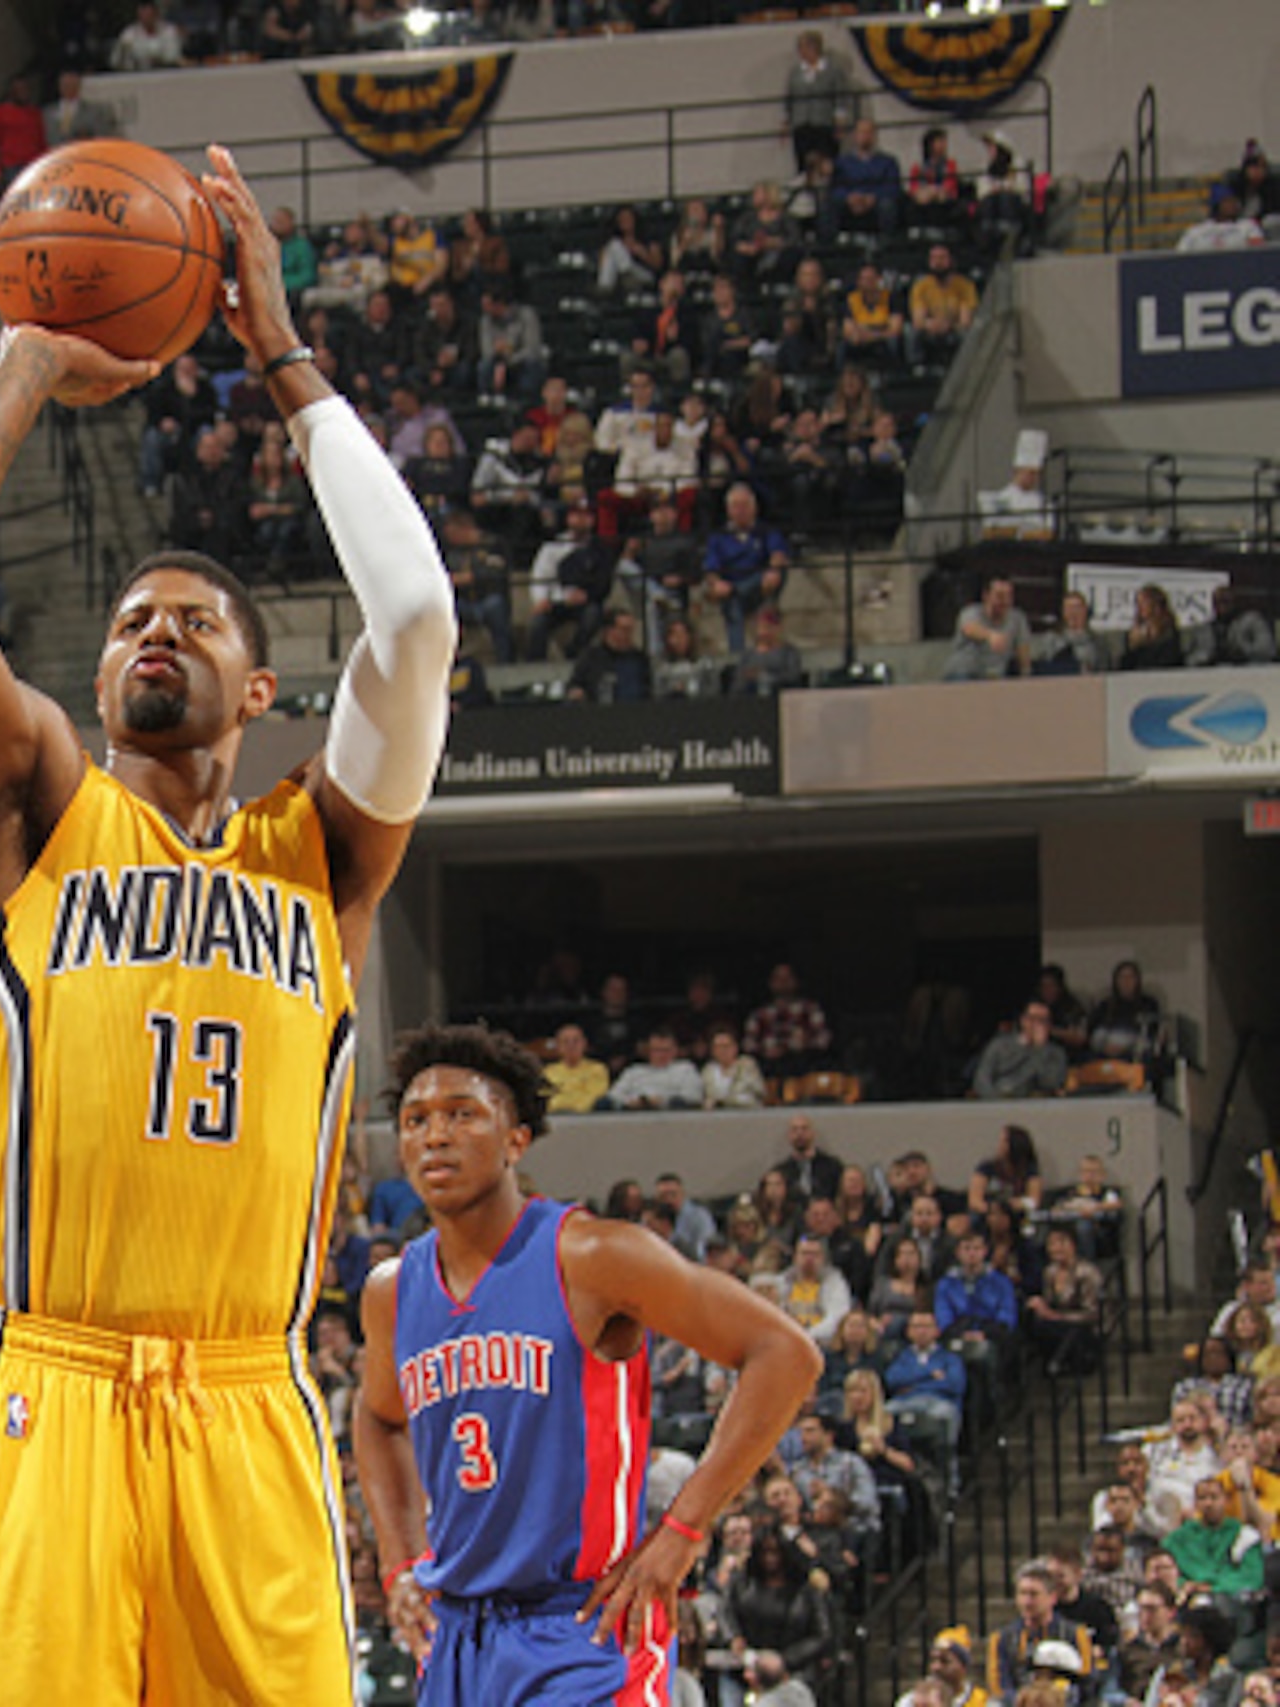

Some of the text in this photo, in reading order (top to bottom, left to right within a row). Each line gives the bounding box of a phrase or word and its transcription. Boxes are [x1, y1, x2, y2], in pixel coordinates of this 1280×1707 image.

[1137, 286, 1280, 355] LEG
[441, 737, 771, 782] Indiana University Health
[48, 862, 325, 1016] INDIANA
[145, 1011, 244, 1146] 13
[1106, 1116, 1122, 1158] 9
[400, 1331, 554, 1420] DETROIT
[452, 1412, 498, 1493] 3
